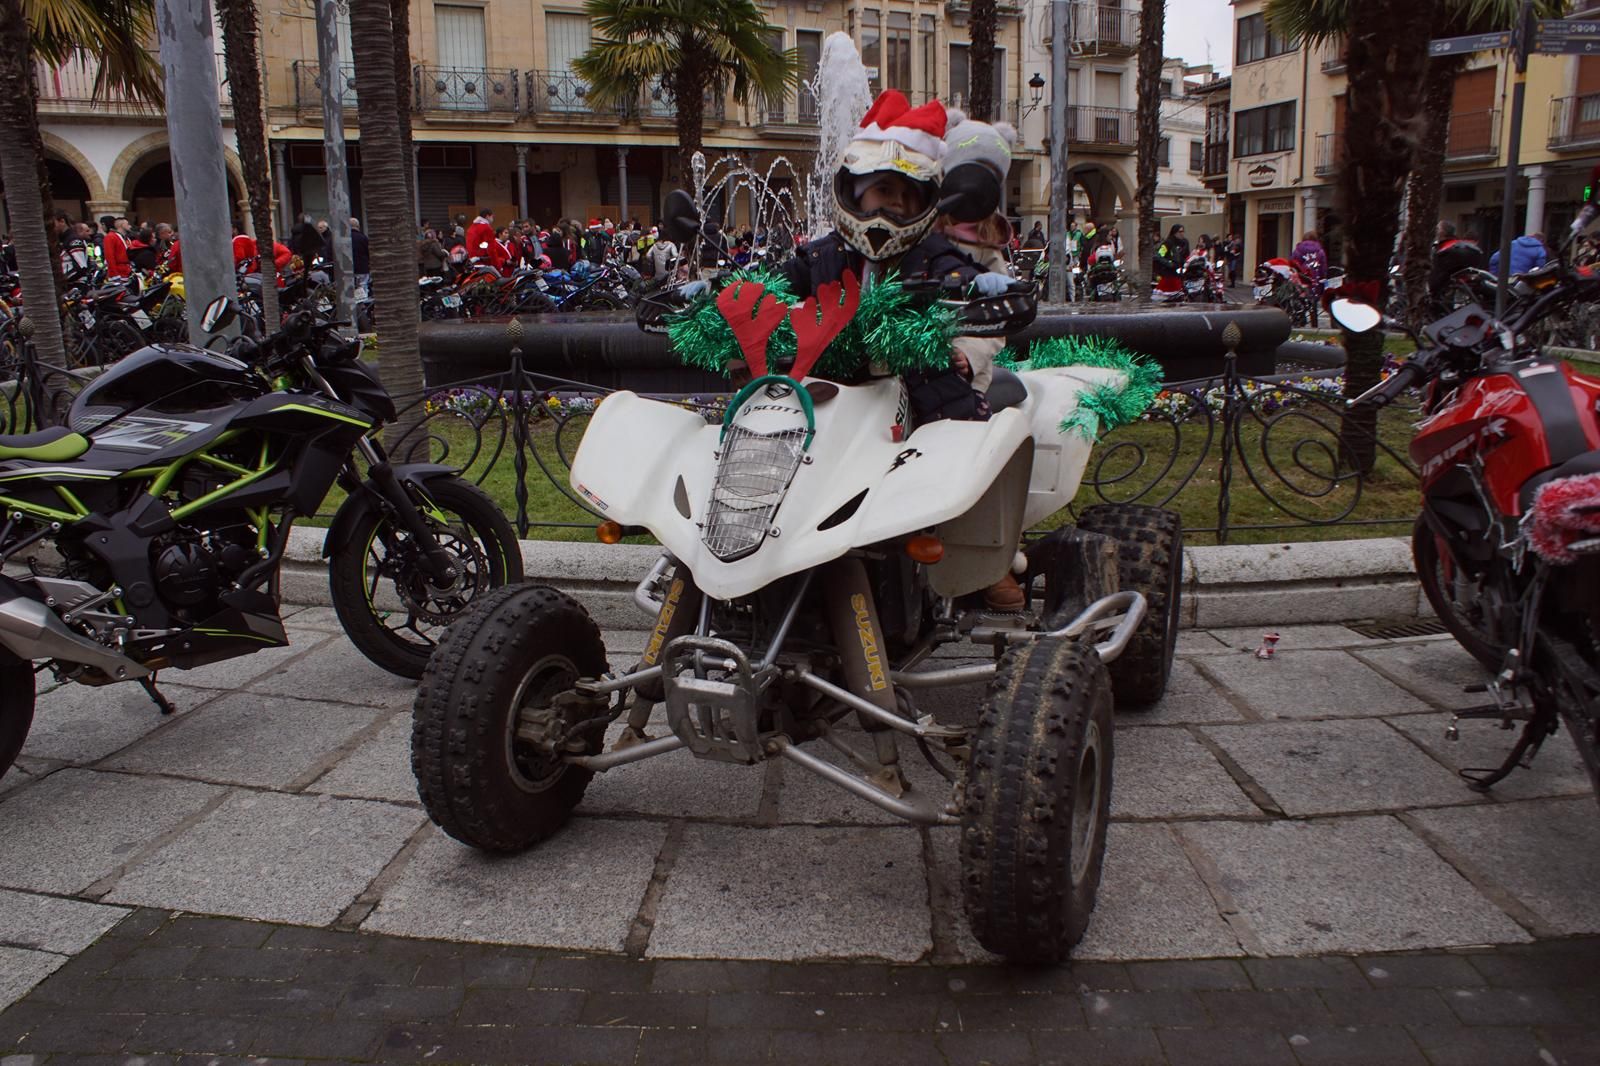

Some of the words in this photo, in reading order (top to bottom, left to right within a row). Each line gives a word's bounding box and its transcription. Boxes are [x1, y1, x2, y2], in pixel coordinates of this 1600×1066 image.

[957, 321, 1007, 333] olisport
[752, 404, 803, 415] SCOTT
[643, 578, 684, 665] SUZUKI
[850, 593, 887, 691] SUZUKI
